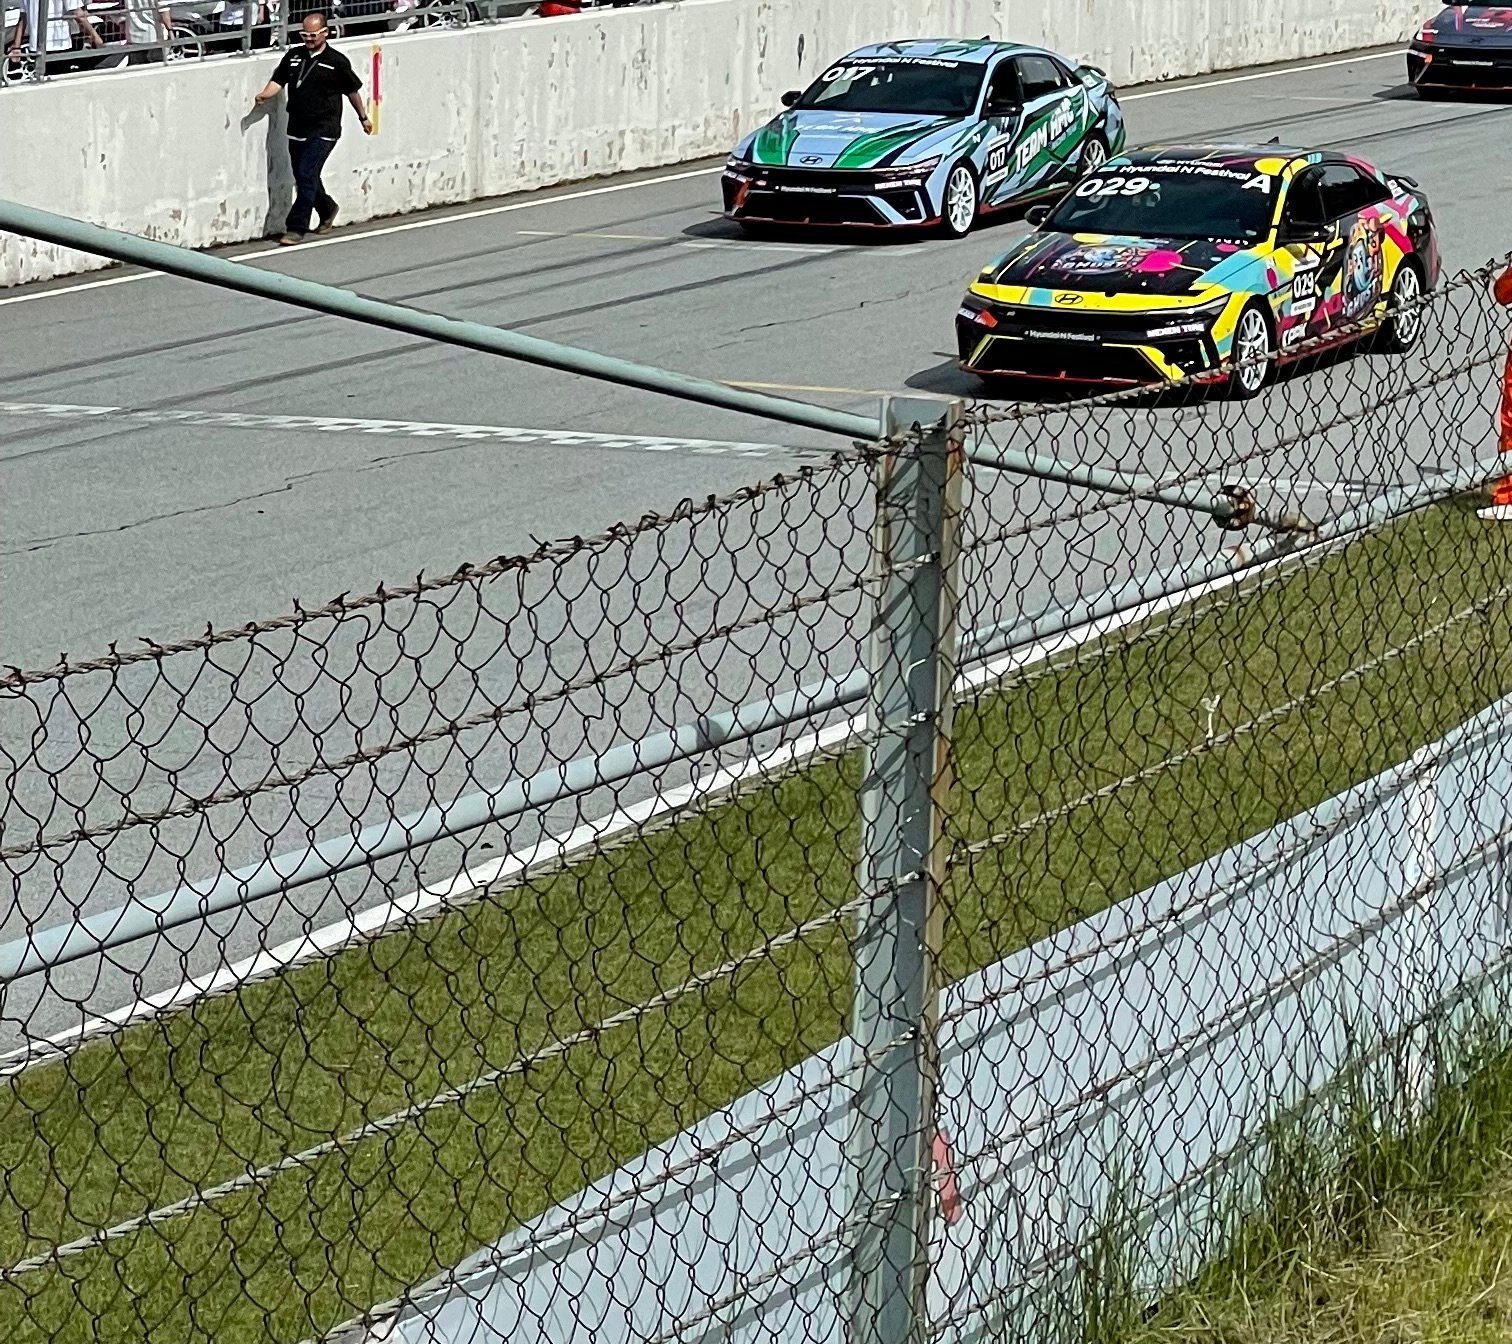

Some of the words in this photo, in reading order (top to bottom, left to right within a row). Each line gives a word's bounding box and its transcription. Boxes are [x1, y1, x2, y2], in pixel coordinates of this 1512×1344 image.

[910, 58, 959, 68] Festival
[821, 66, 876, 82] 017
[1015, 121, 1049, 173] TEAM
[990, 146, 1006, 170] 017
[1119, 165, 1180, 174] Hyundai
[1180, 166, 1193, 174] N
[1193, 166, 1251, 181] Festival
[1075, 177, 1150, 197] 029
[1241, 174, 1271, 194] A
[1293, 271, 1314, 299] 029
[1029, 329, 1060, 340] Hyundai
[1067, 332, 1095, 342] Festival
